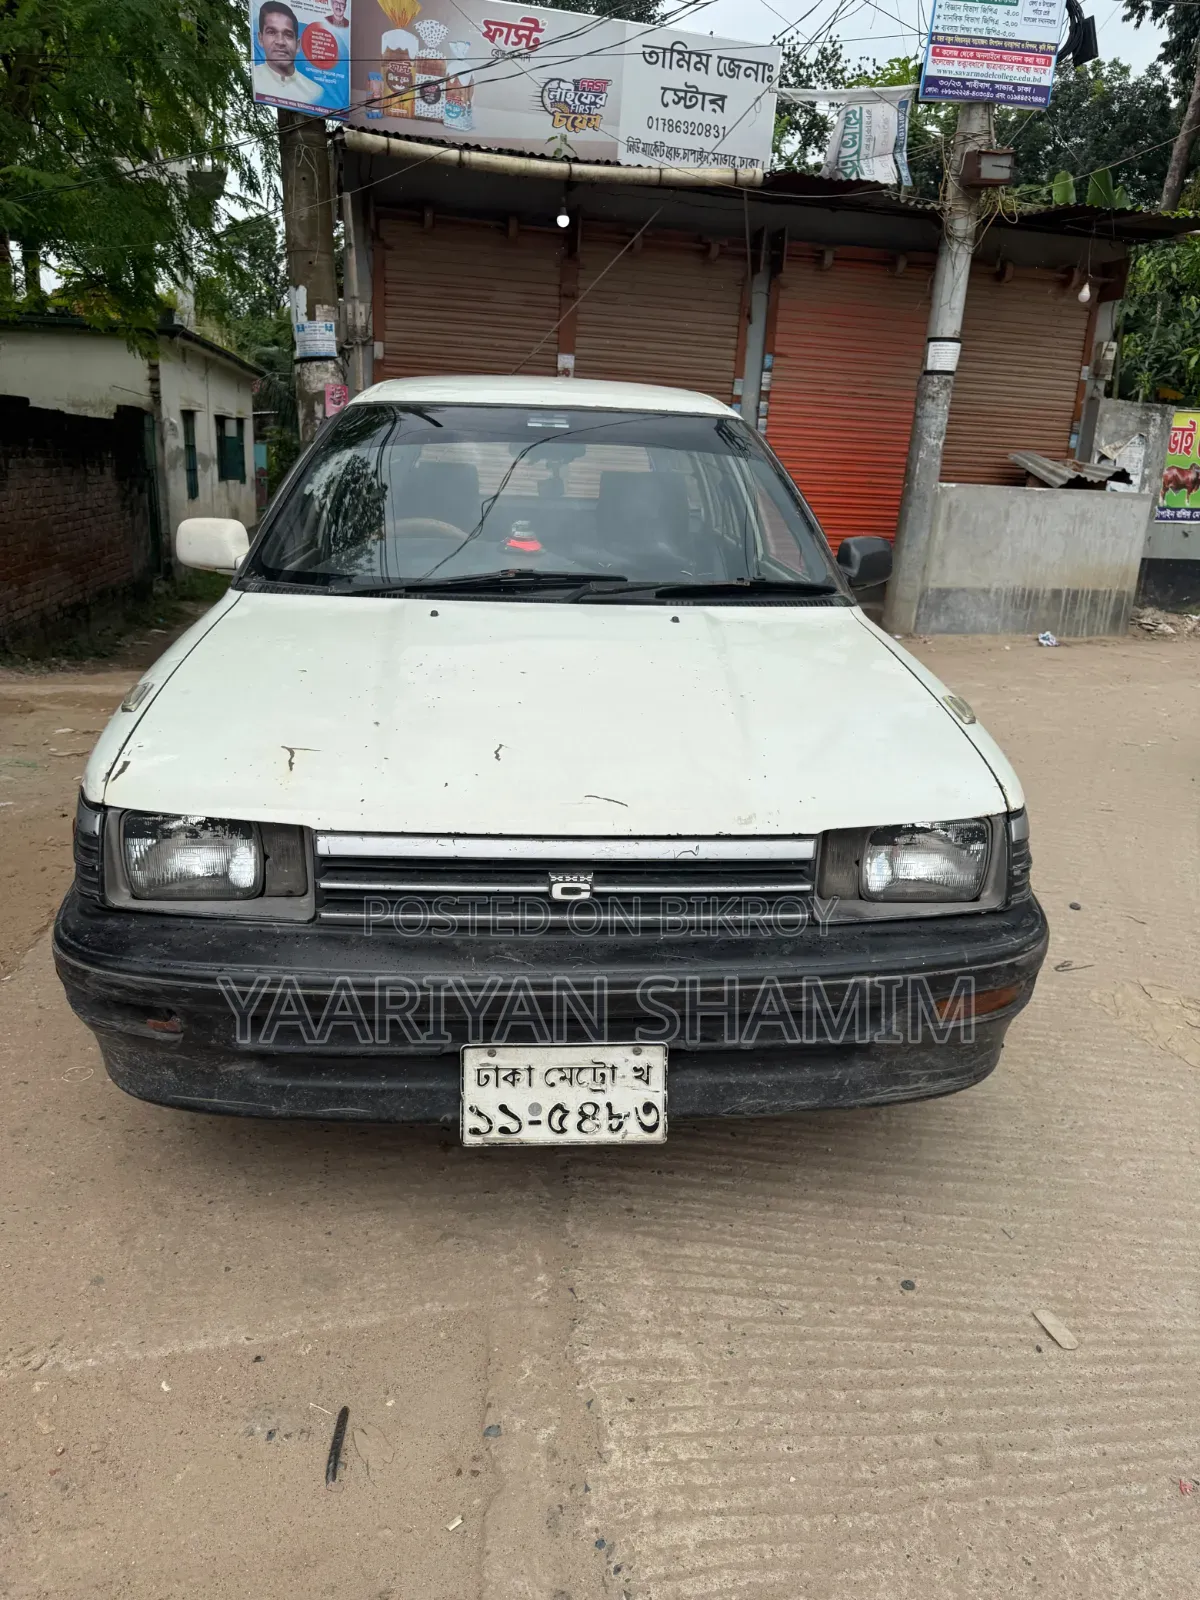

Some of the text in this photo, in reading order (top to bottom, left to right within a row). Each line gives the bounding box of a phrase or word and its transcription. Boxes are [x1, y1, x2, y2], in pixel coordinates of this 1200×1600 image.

[642, 41, 712, 75] তামিম
[548, 81, 607, 108] লাইফের
[579, 79, 608, 92] FAST
[661, 82, 728, 113] স্টোর
[571, 103, 596, 114] FIRST
[647, 115, 726, 139] 01786320831
[626, 135, 641, 154] নিউ
[641, 141, 665, 158] মার্কেট
[475, 1060, 653, 1093] ঢাকা মেট্রো খ
[468, 1101, 660, 1135] ১১-৫৪৮৩
